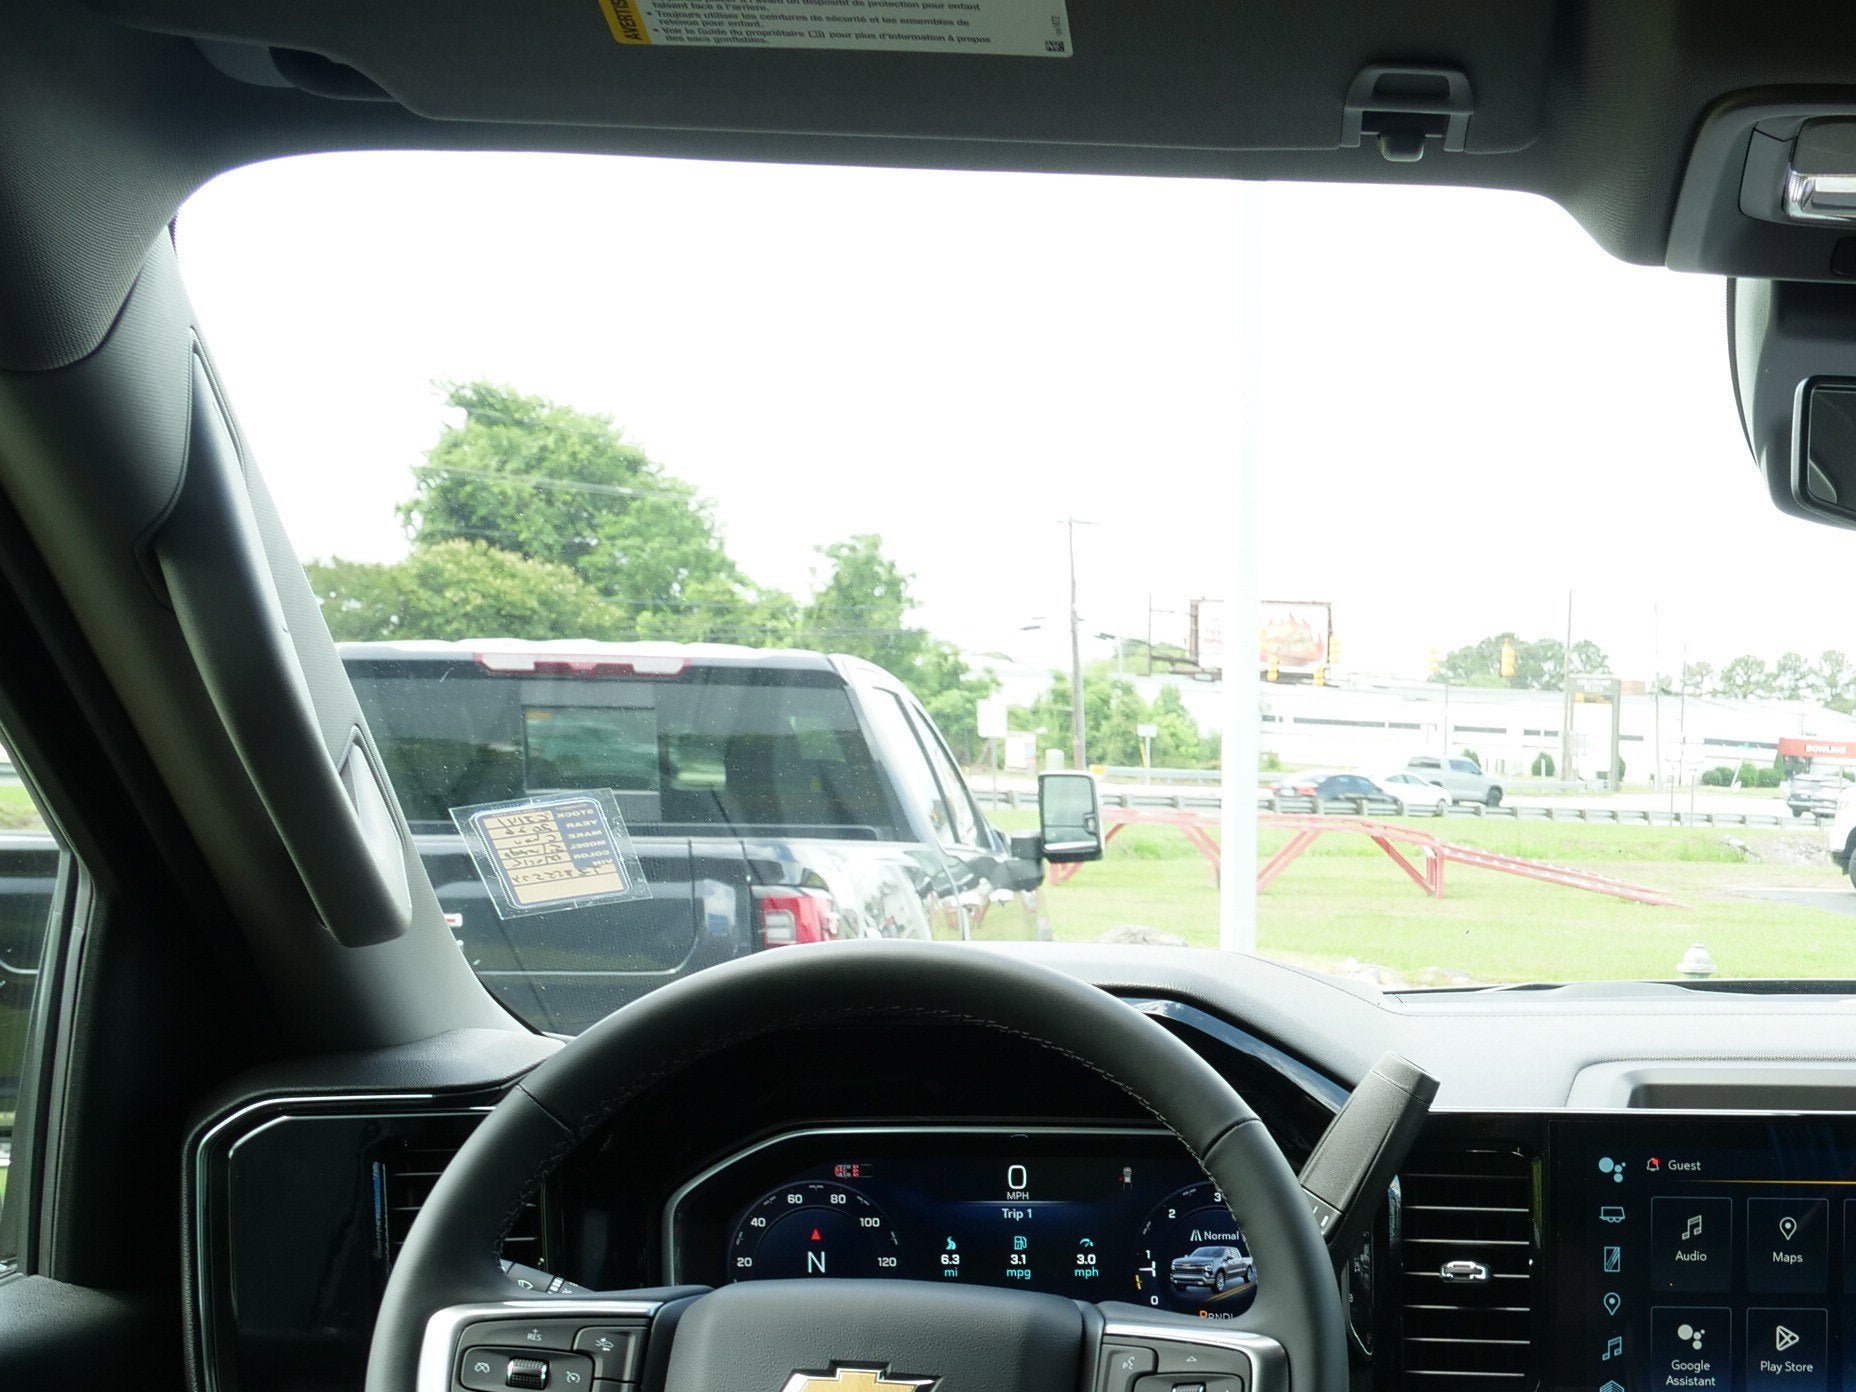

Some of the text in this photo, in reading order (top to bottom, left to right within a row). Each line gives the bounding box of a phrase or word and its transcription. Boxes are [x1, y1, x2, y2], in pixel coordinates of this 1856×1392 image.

[1805, 743, 1847, 755] BOWLING
[1668, 1160, 1702, 1171] Guest
[1007, 1164, 1027, 1190] 0
[787, 1194, 803, 1204] 60
[830, 1194, 846, 1204] 80
[1006, 1191, 1029, 1200] MPH
[1213, 1192, 1222, 1202] 3
[1002, 1208, 1033, 1221] Trip 1
[1168, 1208, 1176, 1219] 2
[750, 1217, 766, 1227] 40
[859, 1217, 880, 1227] 100
[1203, 1230, 1240, 1240] Normal
[940, 1254, 960, 1265] 6.3
[1010, 1254, 1027, 1265] 3.1
[1076, 1254, 1096, 1265] 3.0
[1145, 1249, 1151, 1260] 1
[1675, 1250, 1707, 1262] Audio
[1772, 1251, 1803, 1264] Maps
[737, 1257, 752, 1267] 20
[807, 1250, 826, 1273] N
[877, 1257, 897, 1267] 120
[944, 1267, 958, 1277] mi
[1006, 1268, 1031, 1280] mpg
[1074, 1266, 1099, 1279] mph
[1150, 1295, 1159, 1306] 0
[527, 1333, 542, 1341] RES
[1671, 1360, 1711, 1374] Google
[1760, 1360, 1814, 1375] Play Store
[1665, 1374, 1716, 1387] Assistant
